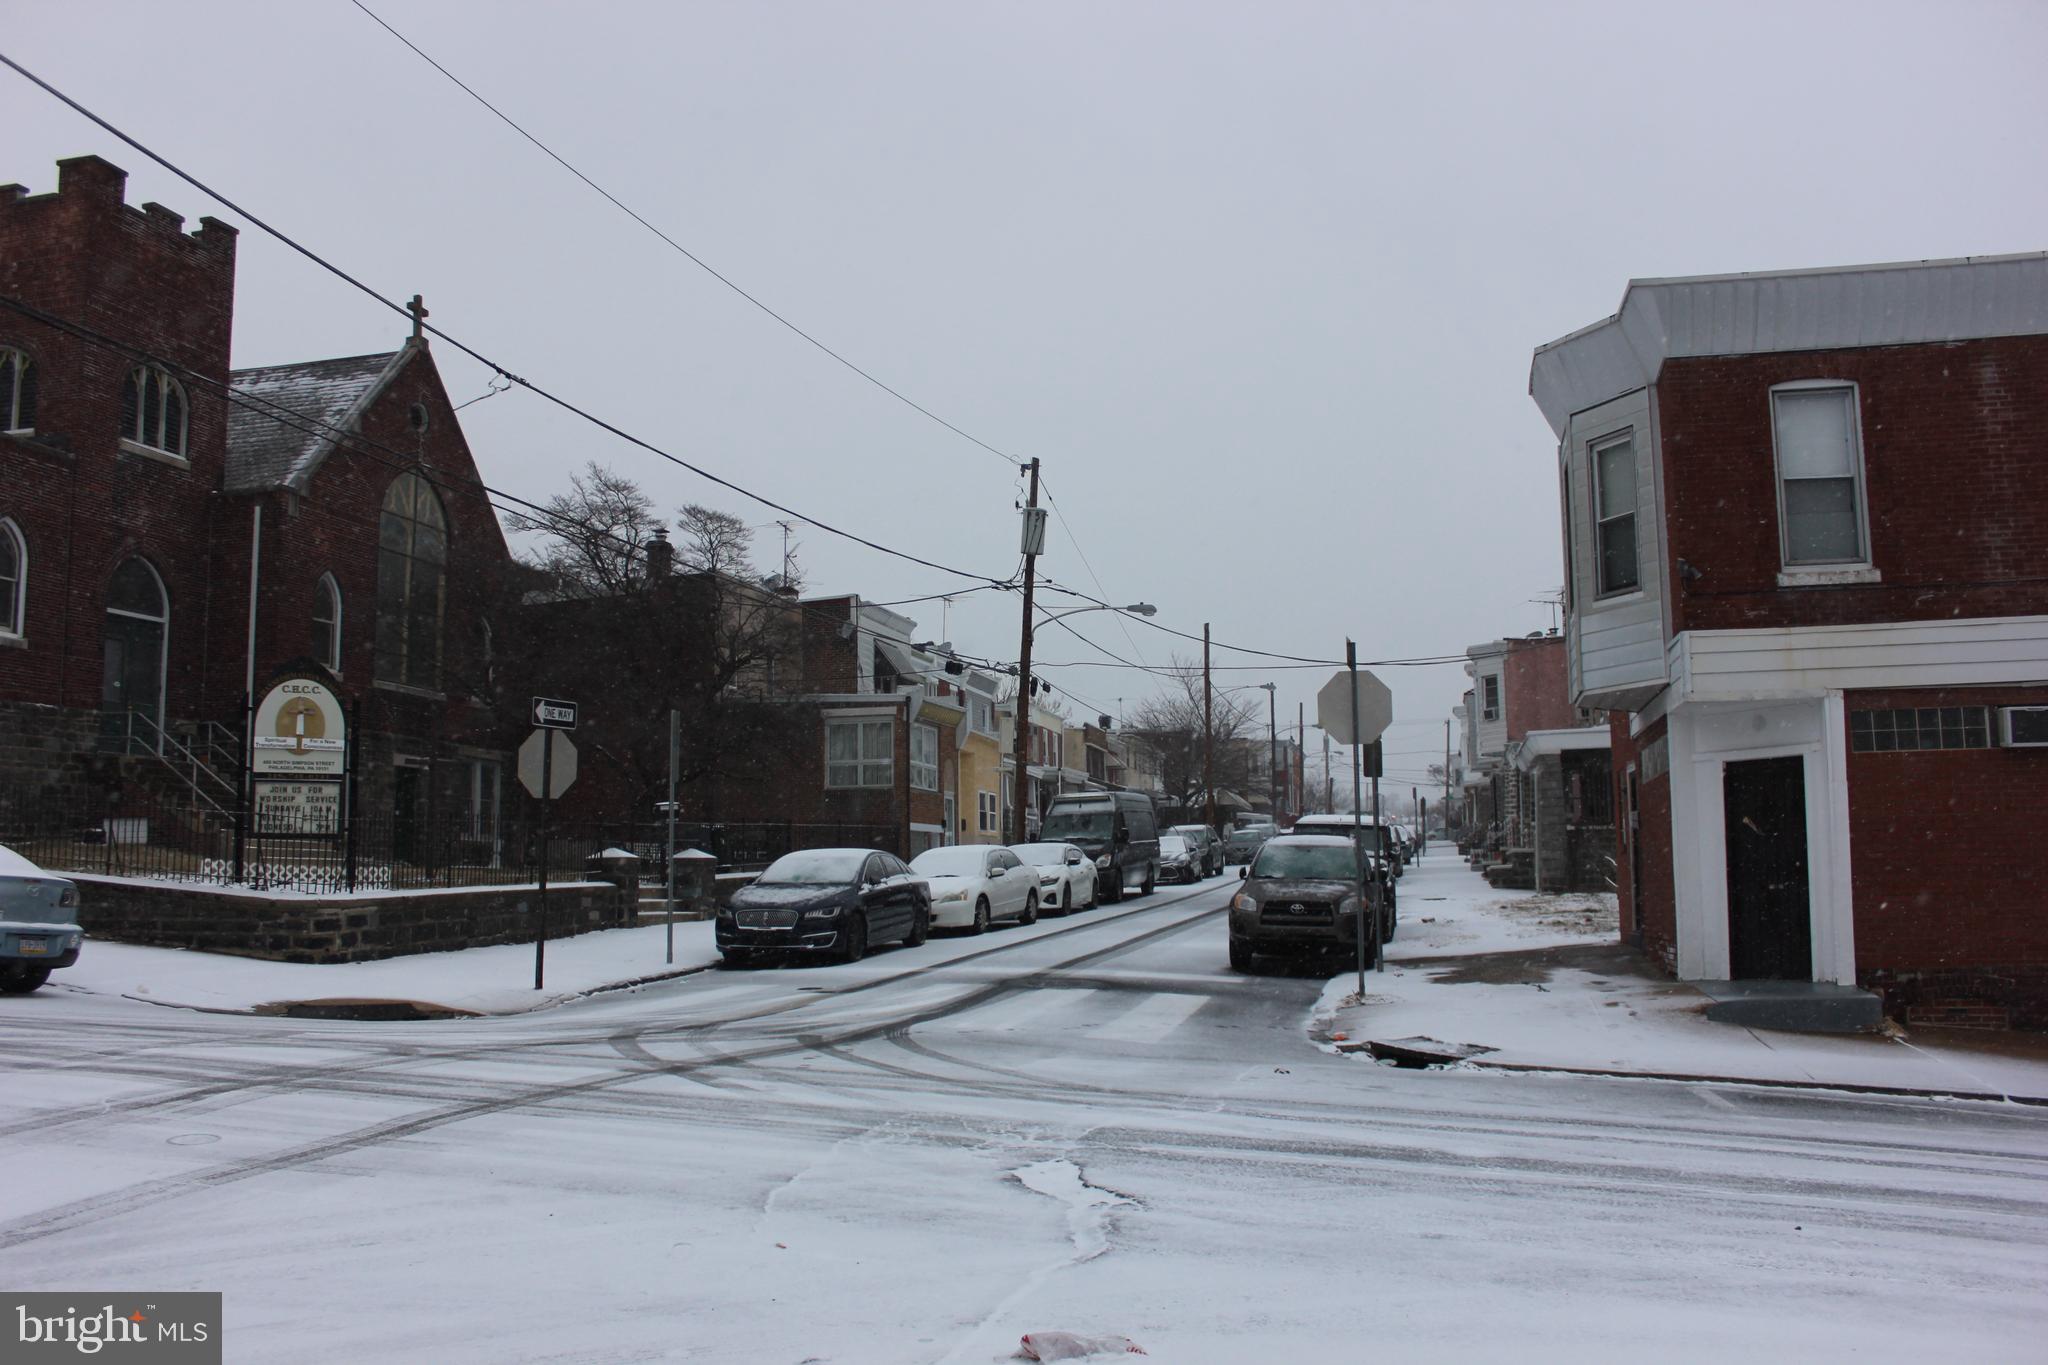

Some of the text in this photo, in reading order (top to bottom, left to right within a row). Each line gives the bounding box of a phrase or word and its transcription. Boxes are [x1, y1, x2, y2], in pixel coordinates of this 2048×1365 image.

[544, 707, 572, 720] ONE WAY
[308, 786, 323, 794] FOR
[259, 795, 296, 803] WORSHIP
